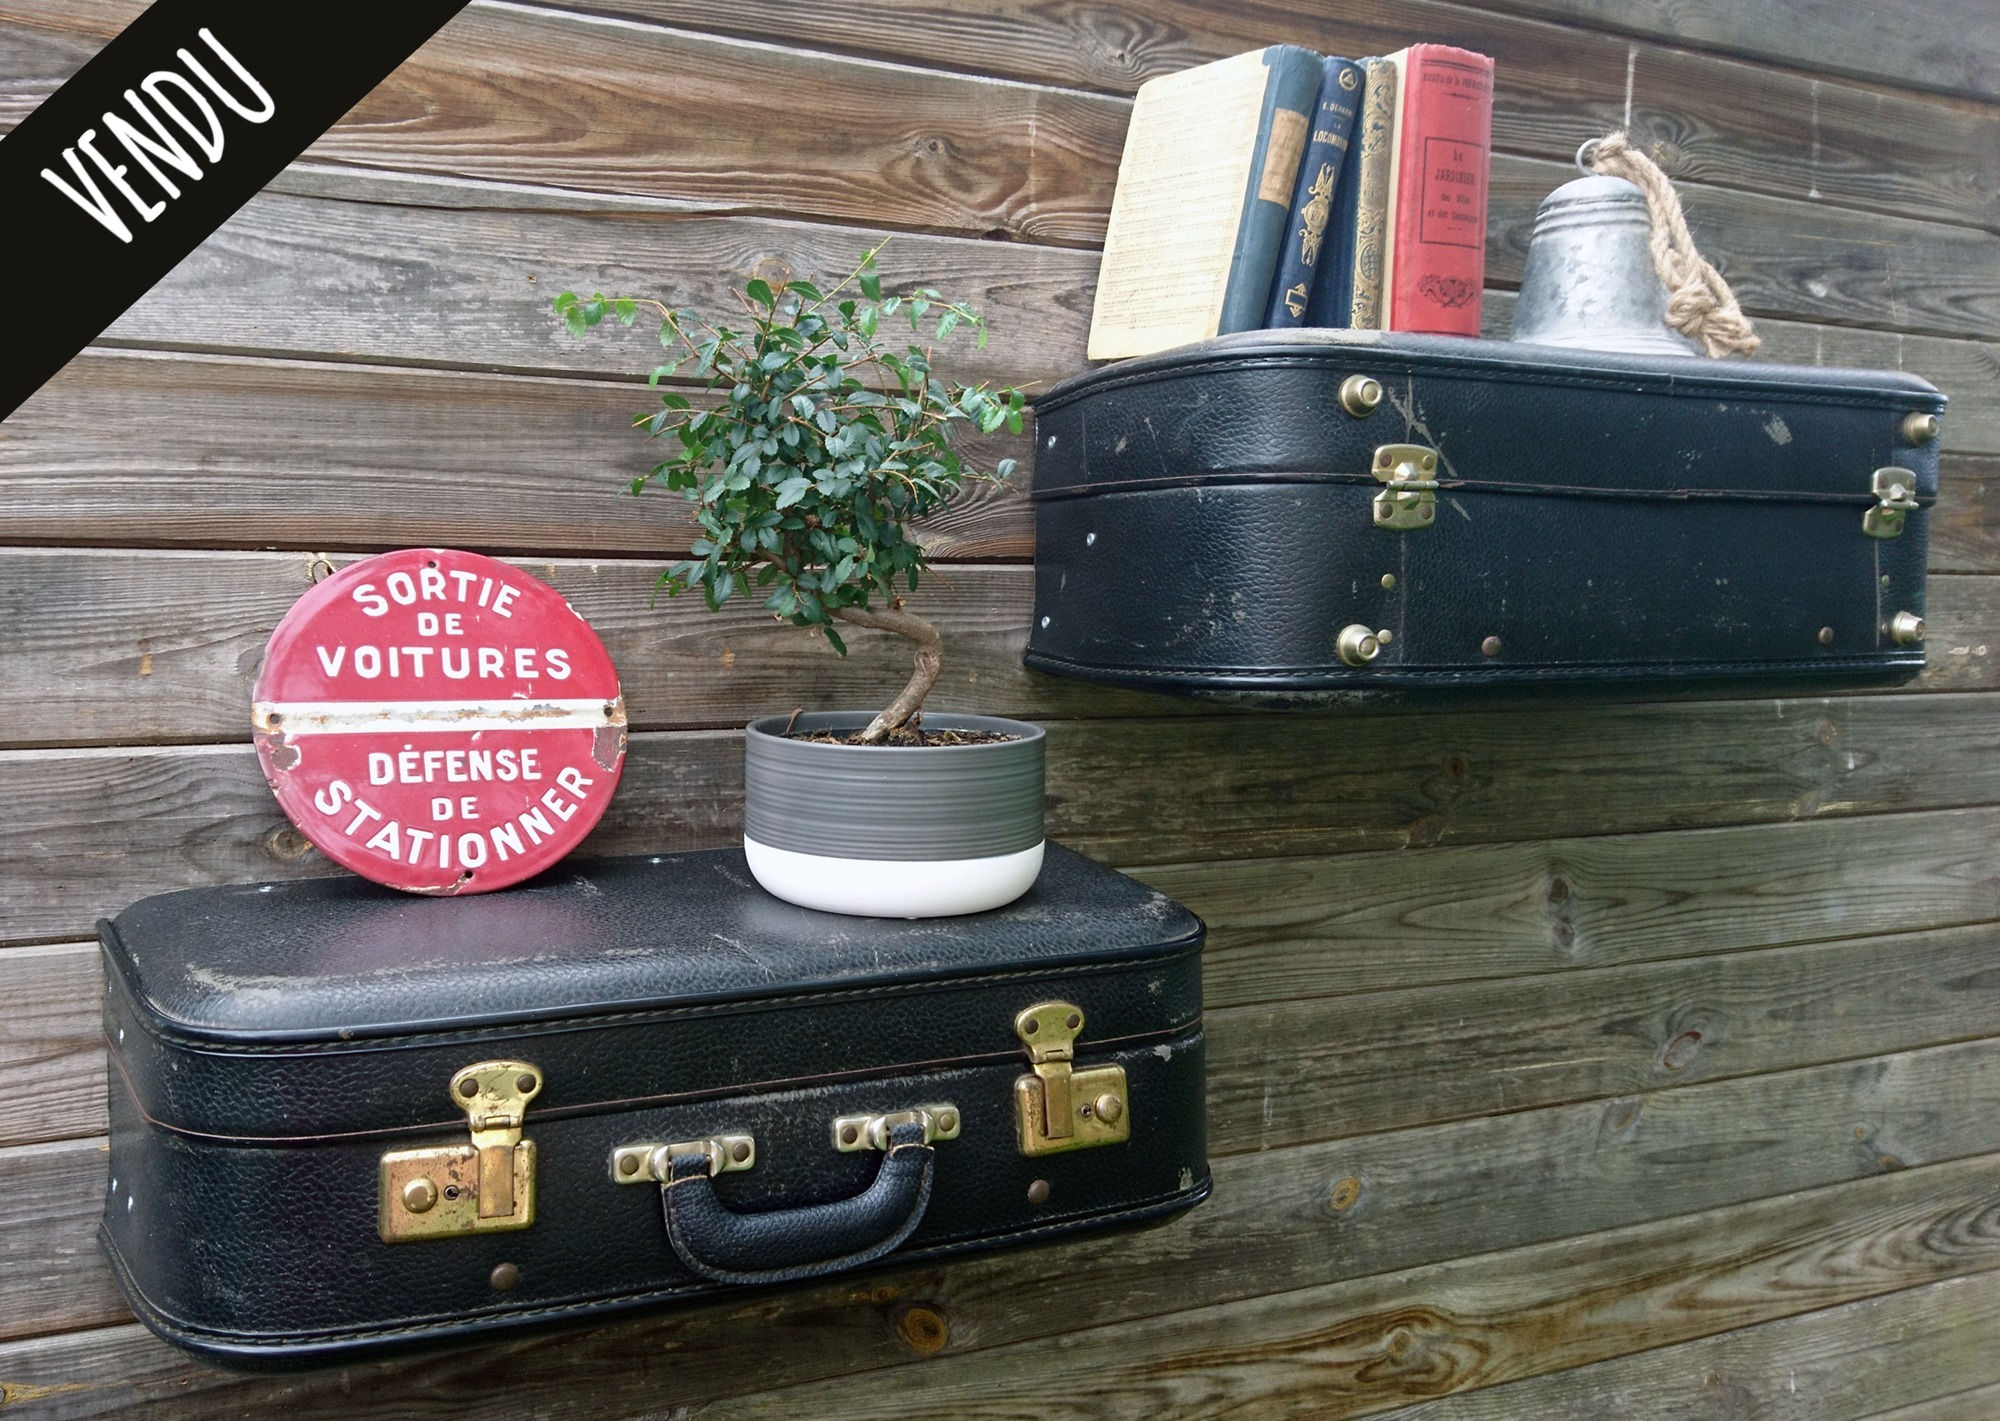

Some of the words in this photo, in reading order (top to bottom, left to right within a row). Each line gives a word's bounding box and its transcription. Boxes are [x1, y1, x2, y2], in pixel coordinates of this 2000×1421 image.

[353, 568, 520, 618] SORTIE
[417, 612, 464, 636] DE
[316, 646, 571, 680] VOITURES
[368, 744, 542, 785] DÉFENSE
[314, 767, 593, 869] STATIONNER
[431, 796, 480, 821] DE
